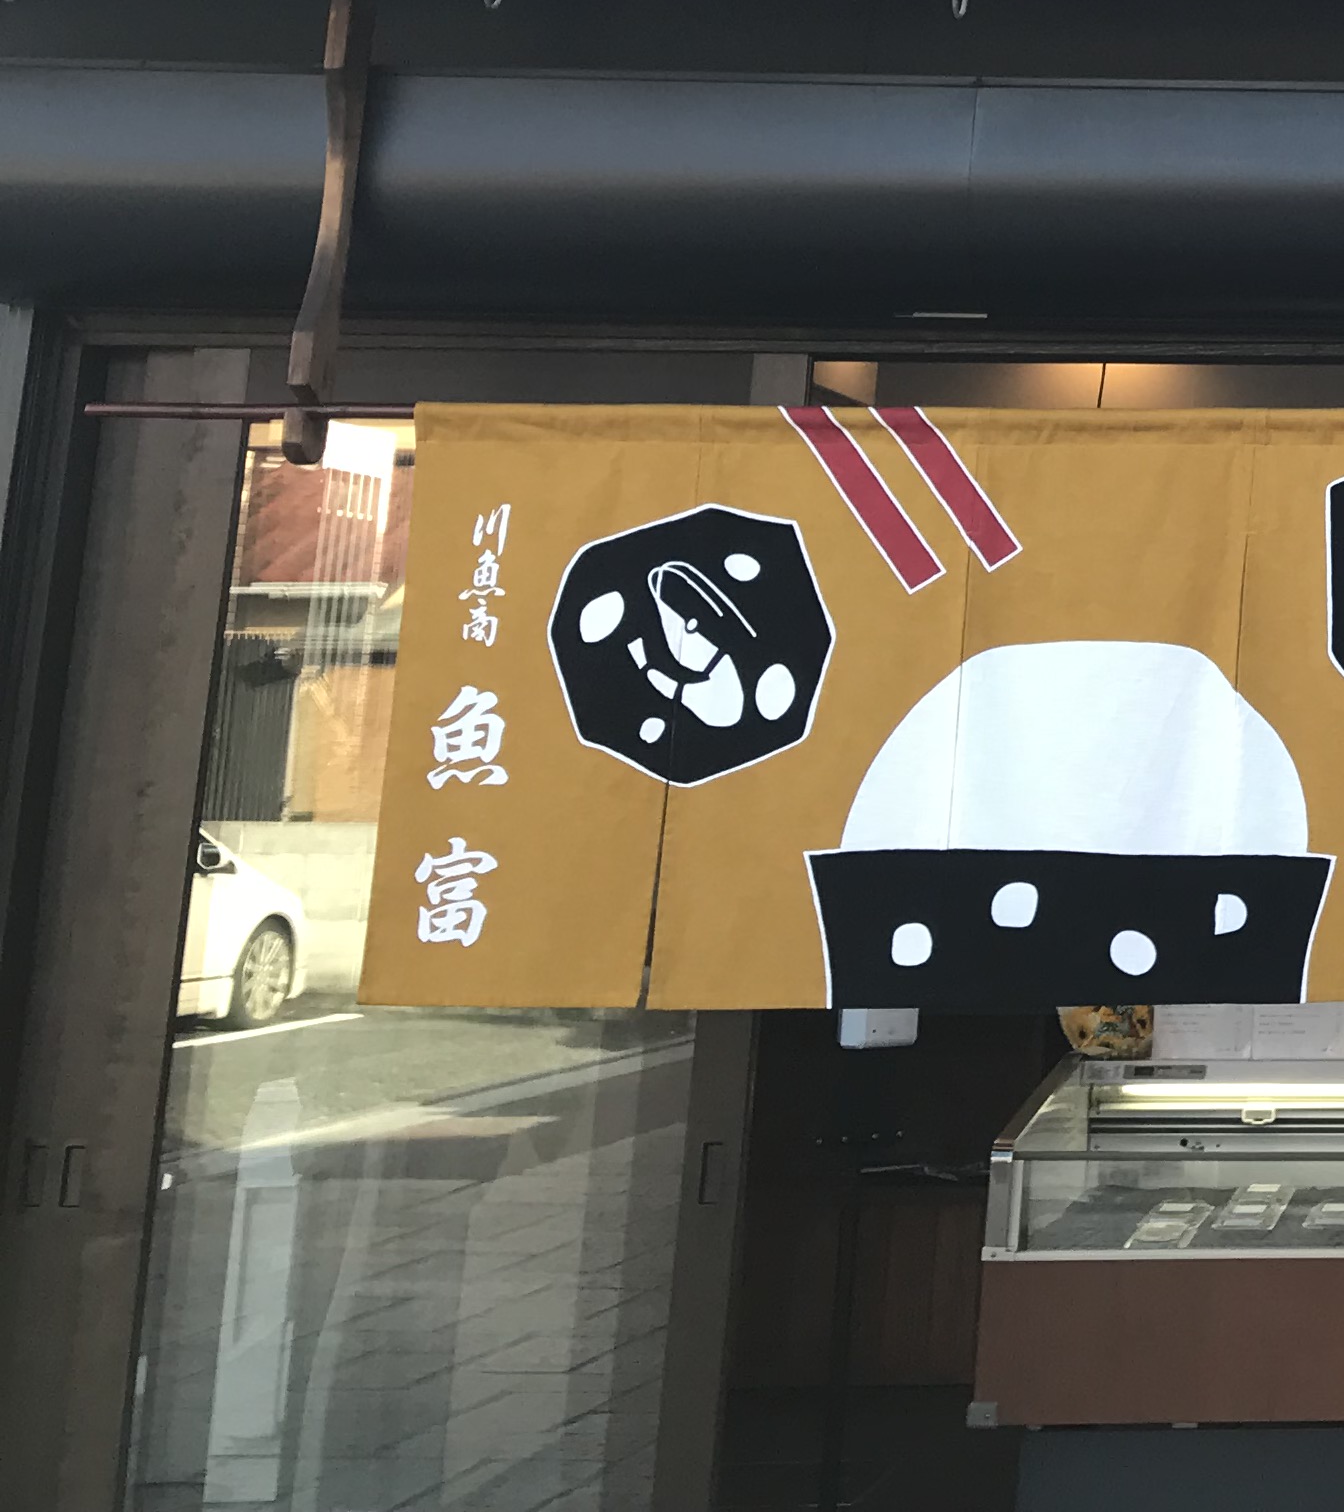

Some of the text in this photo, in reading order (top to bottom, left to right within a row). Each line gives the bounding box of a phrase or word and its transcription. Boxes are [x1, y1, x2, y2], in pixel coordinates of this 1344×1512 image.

[413, 502, 511, 949] 川魚商 魚富
